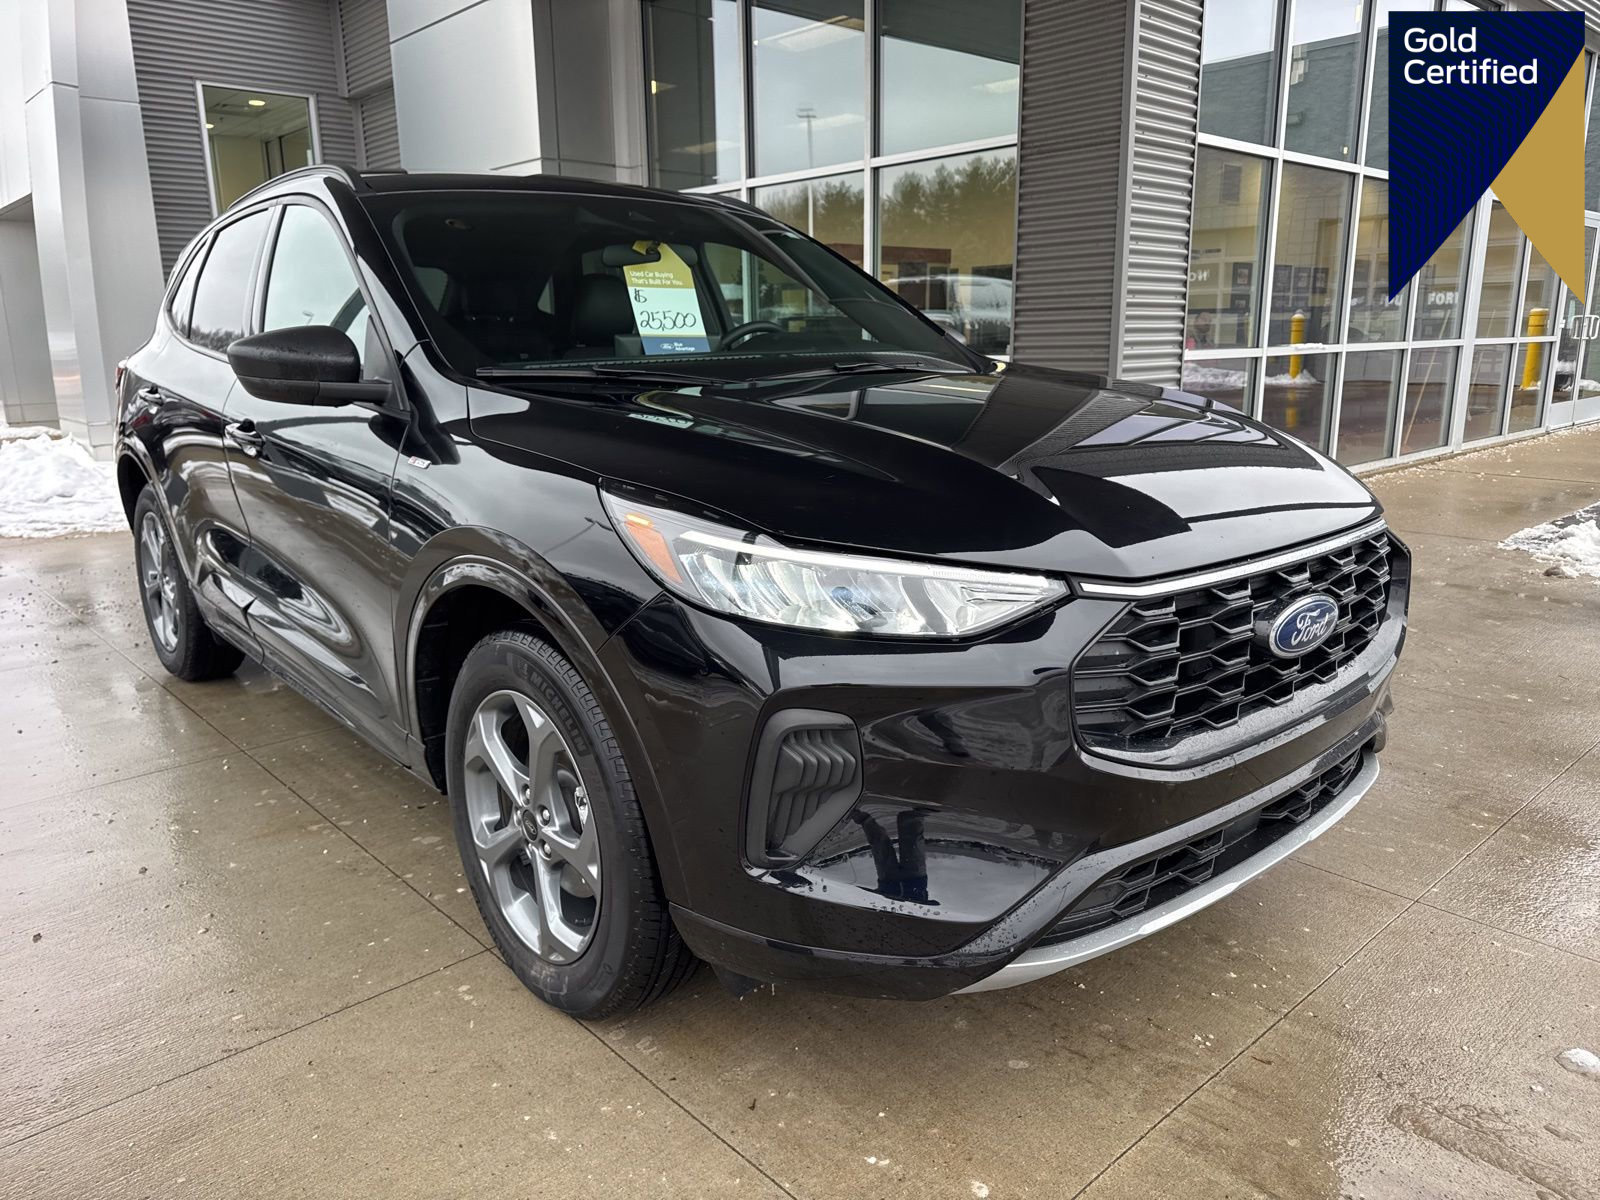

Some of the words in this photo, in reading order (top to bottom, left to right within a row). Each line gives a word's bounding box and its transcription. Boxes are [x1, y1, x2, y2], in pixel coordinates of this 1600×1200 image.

[640, 310, 697, 332] 25,500
[1291, 609, 1329, 646] Ford
[530, 671, 588, 756] MICHELIN
